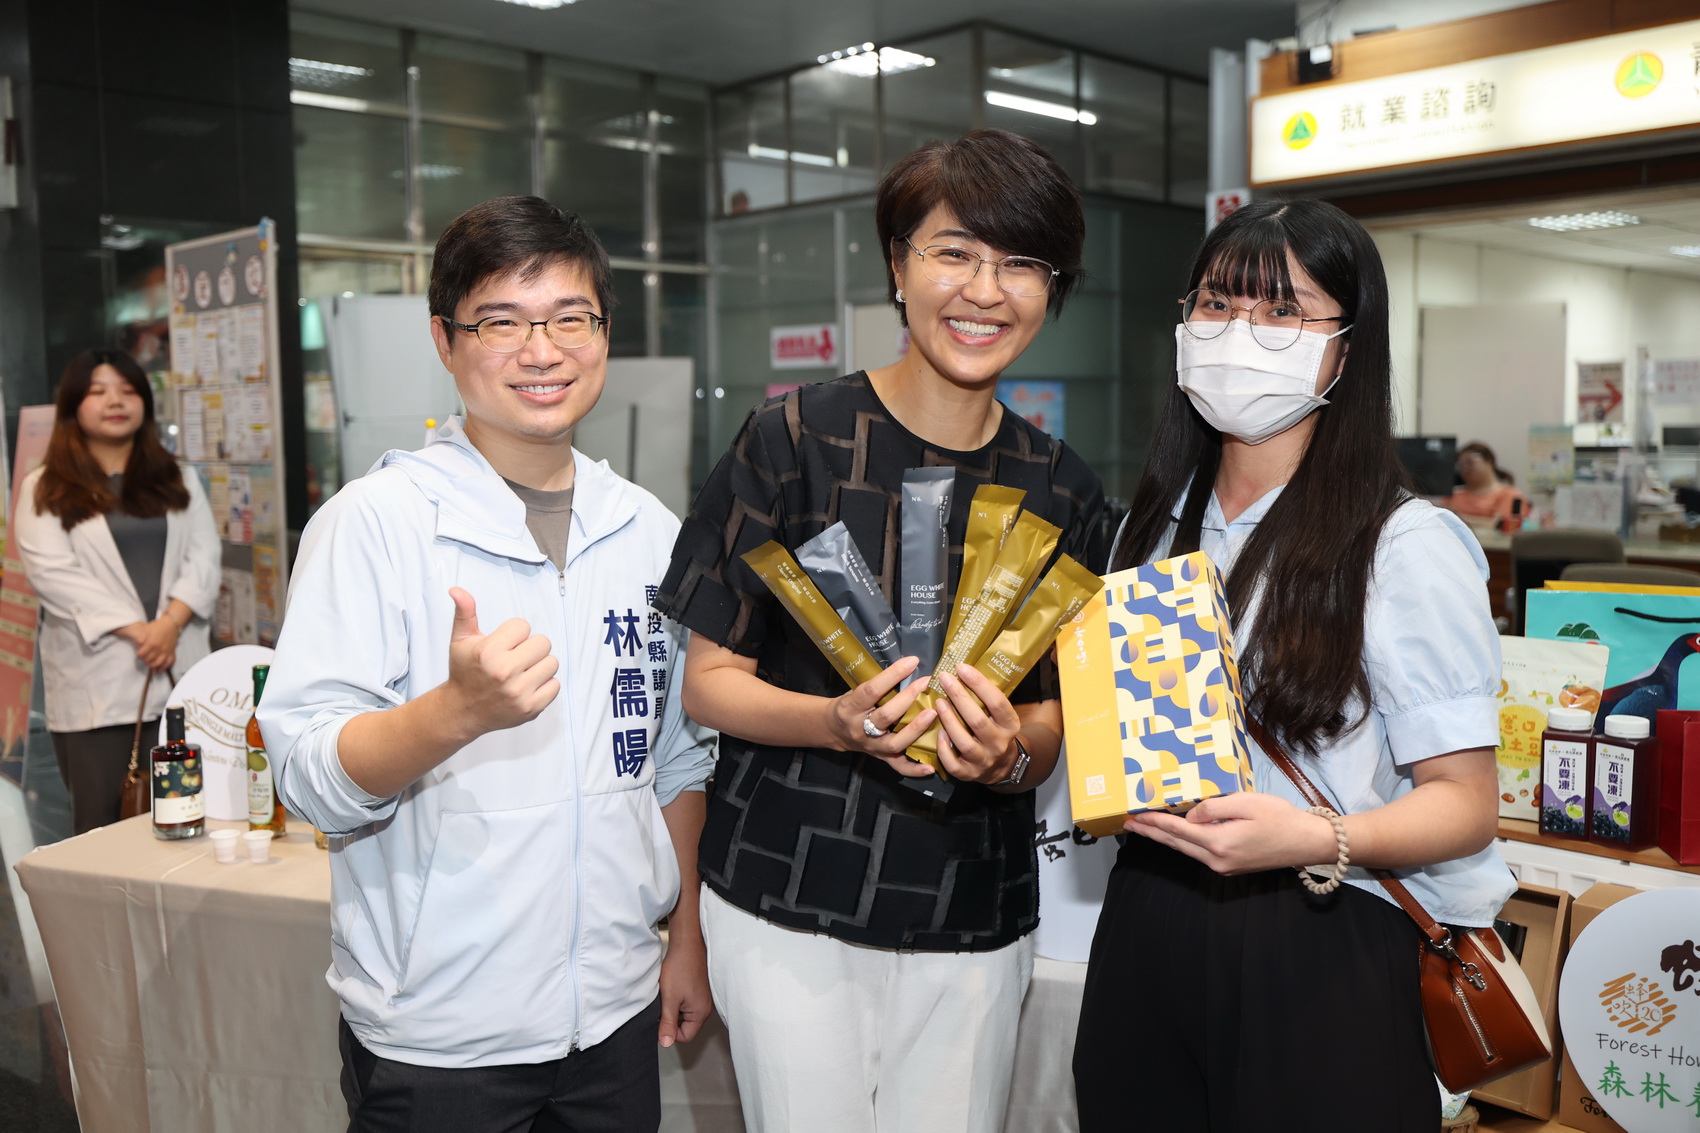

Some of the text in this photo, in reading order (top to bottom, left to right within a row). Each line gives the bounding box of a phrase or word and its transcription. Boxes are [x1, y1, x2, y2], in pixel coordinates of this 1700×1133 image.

[1340, 78, 1497, 132] 就業諮詢
[910, 584, 928, 592] EGG
[823, 628, 844, 645] WHITE
[877, 623, 895, 640] WHITE
[645, 584, 668, 720] 南投縣議員
[995, 650, 1011, 665] EGG
[990, 656, 1014, 676] HOUSE
[210, 687, 254, 712] OM
[603, 608, 649, 780] 林儒暘
[1558, 757, 1571, 790] 不要凍
[1607, 761, 1620, 796] 不要凍
[1641, 1006, 1662, 1022] 20
[1596, 1033, 1662, 1060] Forest
